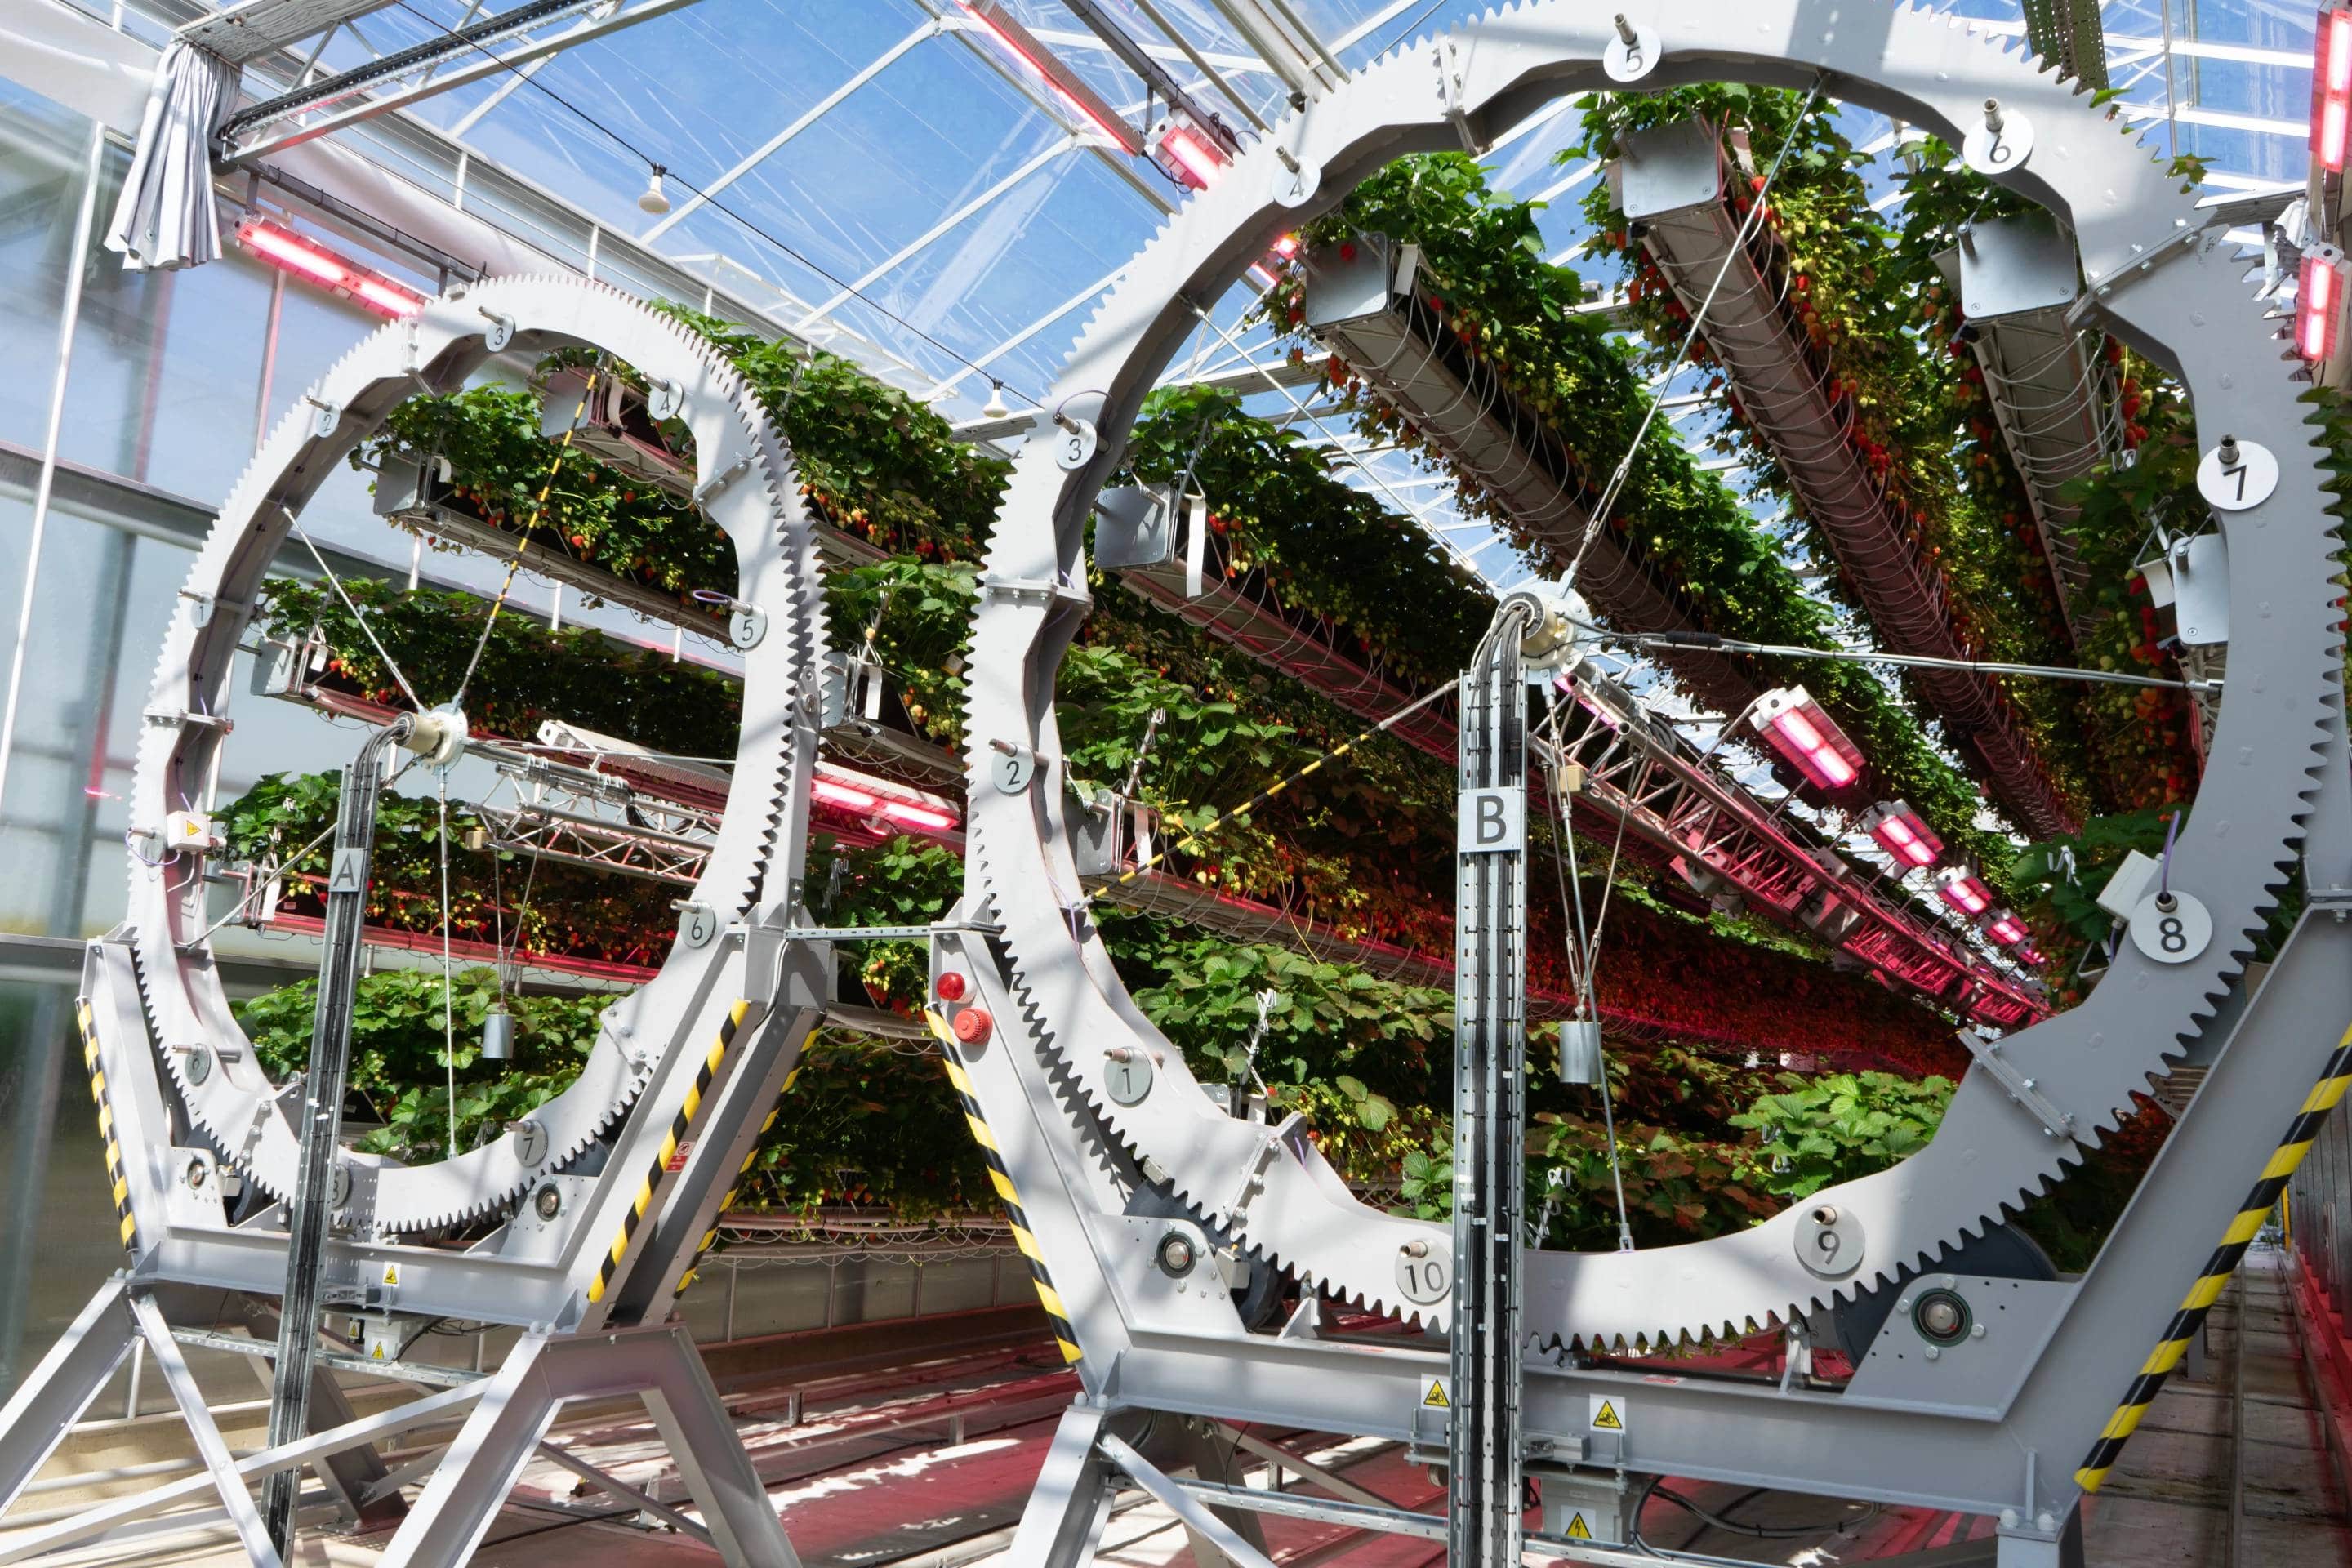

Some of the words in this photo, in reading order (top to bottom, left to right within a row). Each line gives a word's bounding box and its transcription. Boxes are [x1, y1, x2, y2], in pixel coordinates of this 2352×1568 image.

[1627, 46, 1643, 73] 5
[1989, 135, 2011, 164] 6
[1289, 175, 1304, 197] 4
[495, 327, 503, 345] 3
[660, 393, 670, 412] 4
[324, 415, 332, 431] 2
[1069, 439, 1082, 461] 3
[2223, 465, 2247, 501] 7
[199, 606, 205, 622] 1
[742, 620, 754, 641] 5
[1007, 761, 1021, 786] 2
[1477, 795, 1506, 844] B
[333, 853, 354, 887] A
[692, 917, 703, 942] 6
[2160, 917, 2187, 953] 8
[1123, 1068, 1131, 1094] 1
[523, 1137, 533, 1160] 7
[1818, 1231, 1839, 1264] 9
[1405, 1262, 1445, 1294] 10
